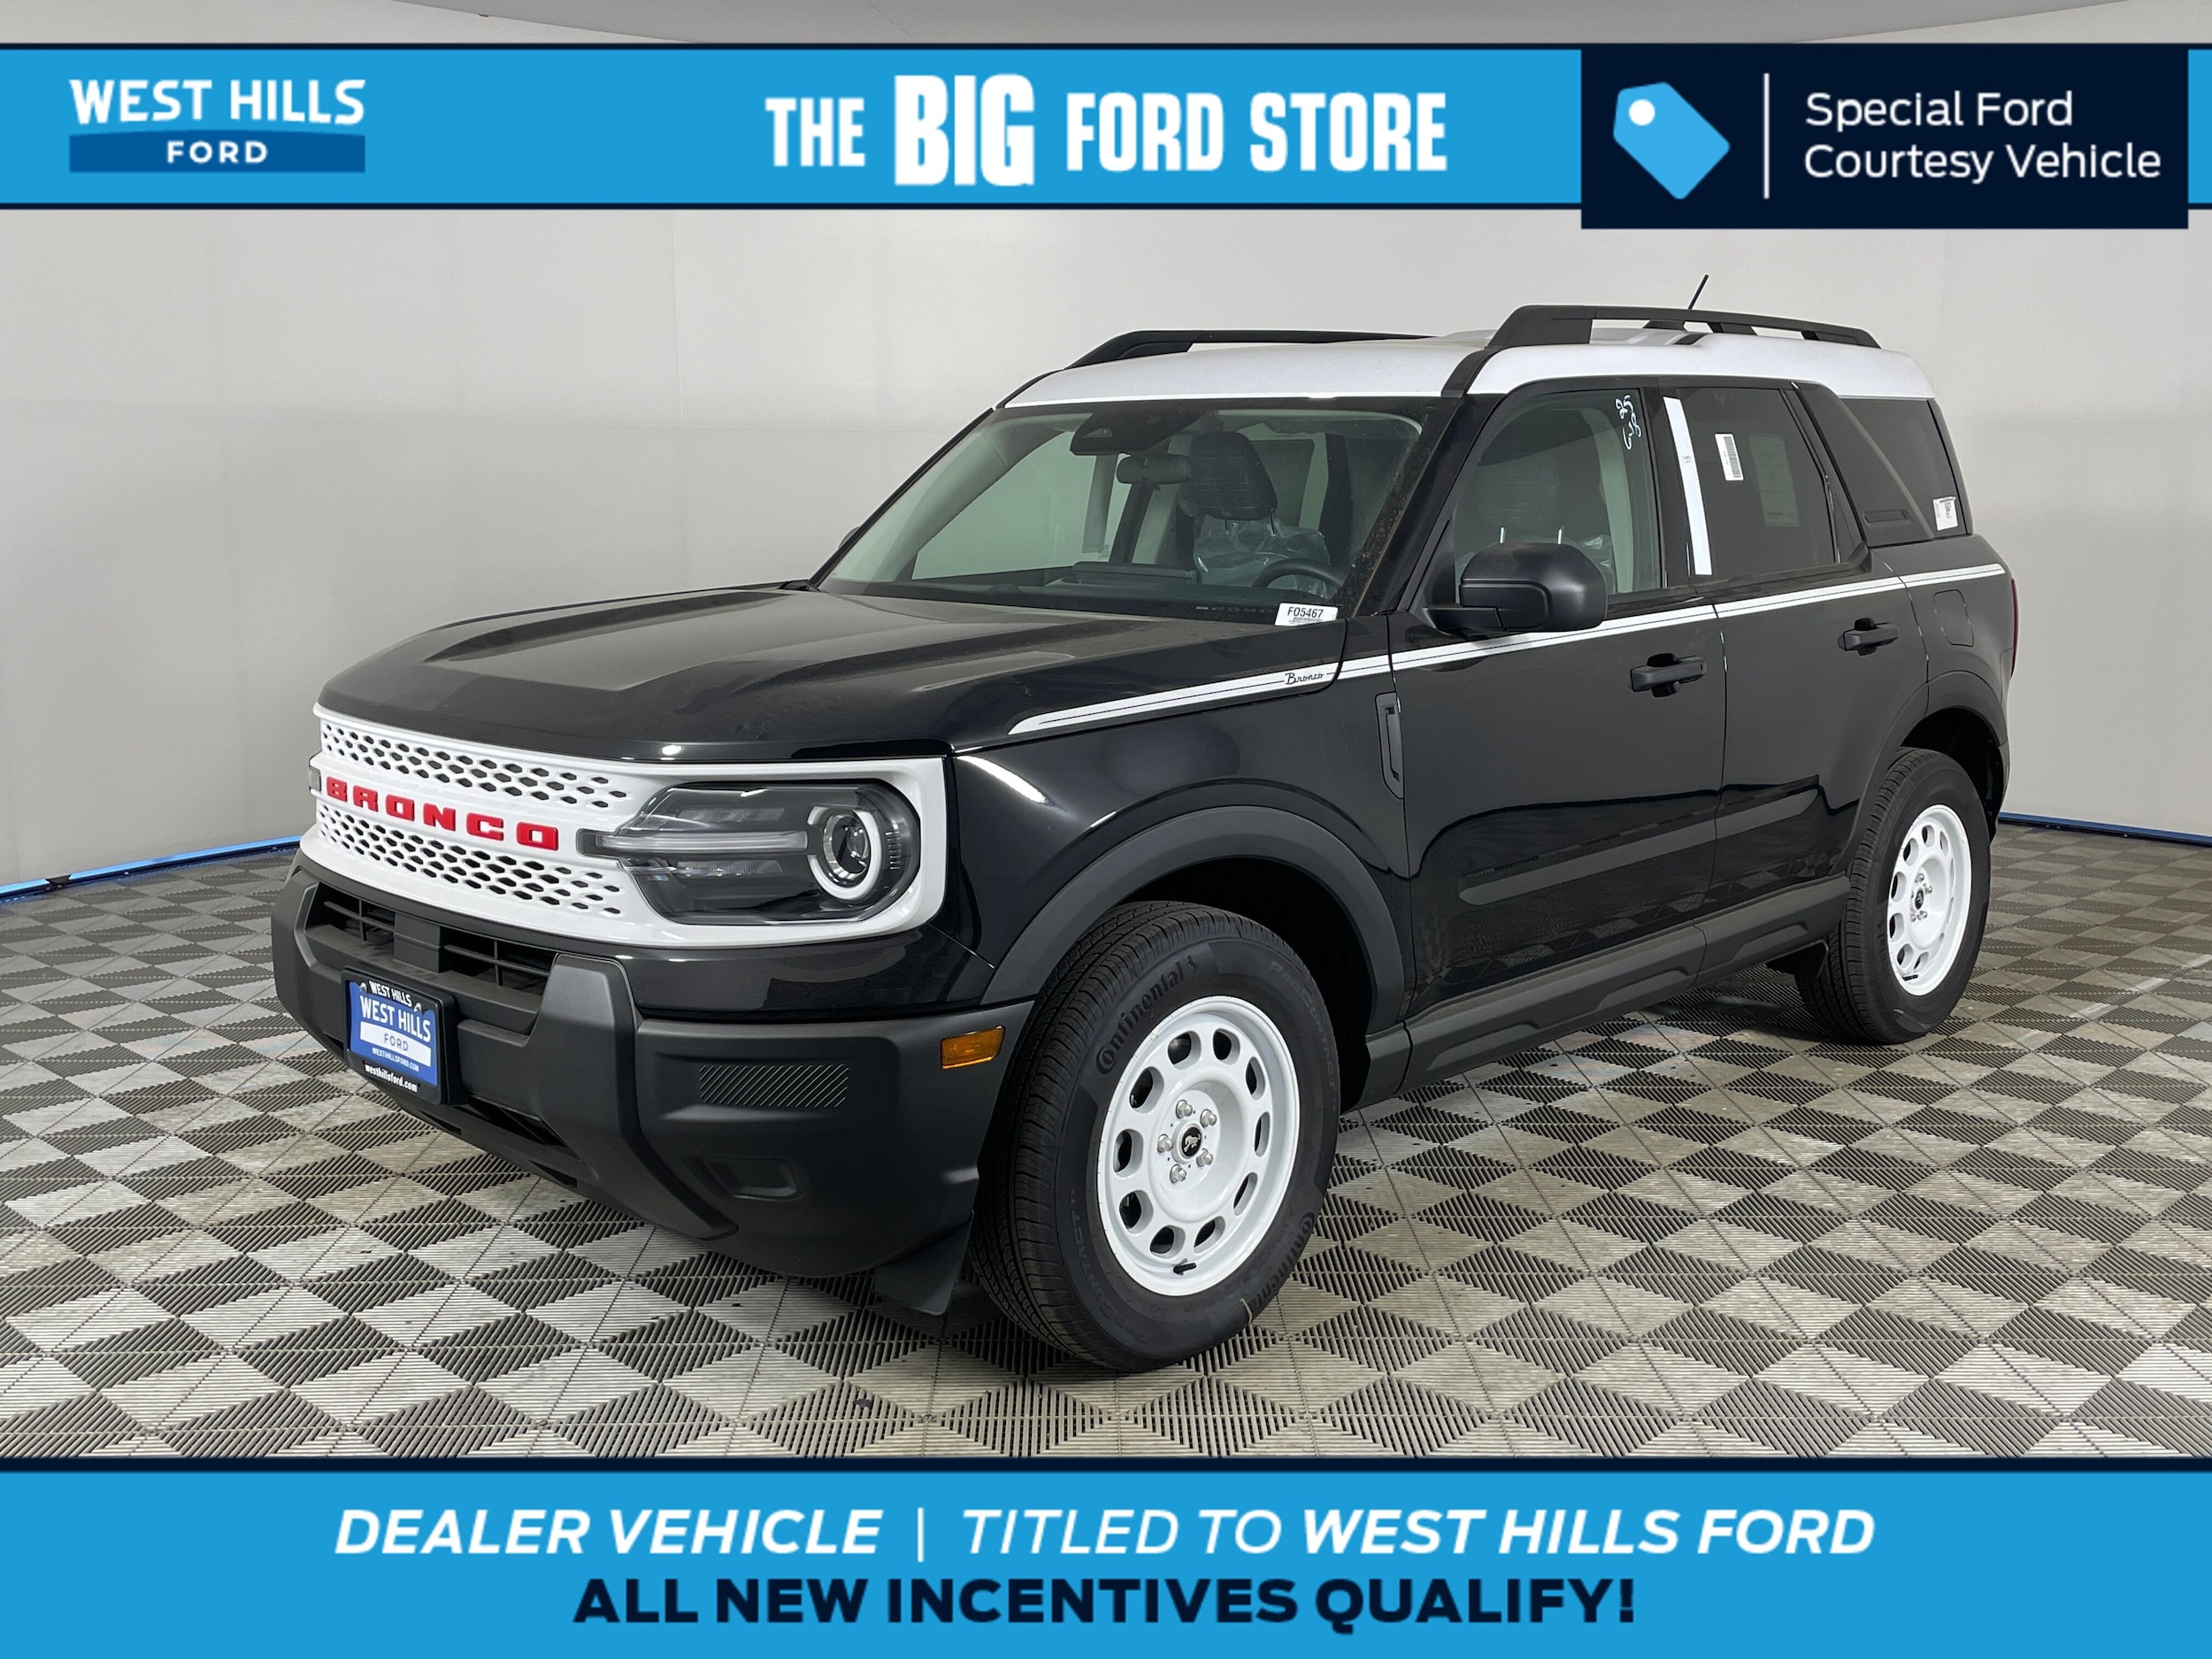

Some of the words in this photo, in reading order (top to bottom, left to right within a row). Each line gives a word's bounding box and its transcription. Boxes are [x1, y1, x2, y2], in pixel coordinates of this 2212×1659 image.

[1284, 672, 1325, 686] Bronco
[326, 775, 559, 851] BRONCO
[368, 979, 392, 998] WEST
[391, 987, 412, 1008] HILLS
[359, 995, 396, 1026] WEST
[397, 1009, 432, 1043] HILLS
[1095, 961, 1185, 1076] Continental
[383, 1033, 410, 1052] FORD
[371, 1047, 419, 1072] WESTHILLSFORD.COM
[364, 1064, 419, 1093] westhillsford.com
